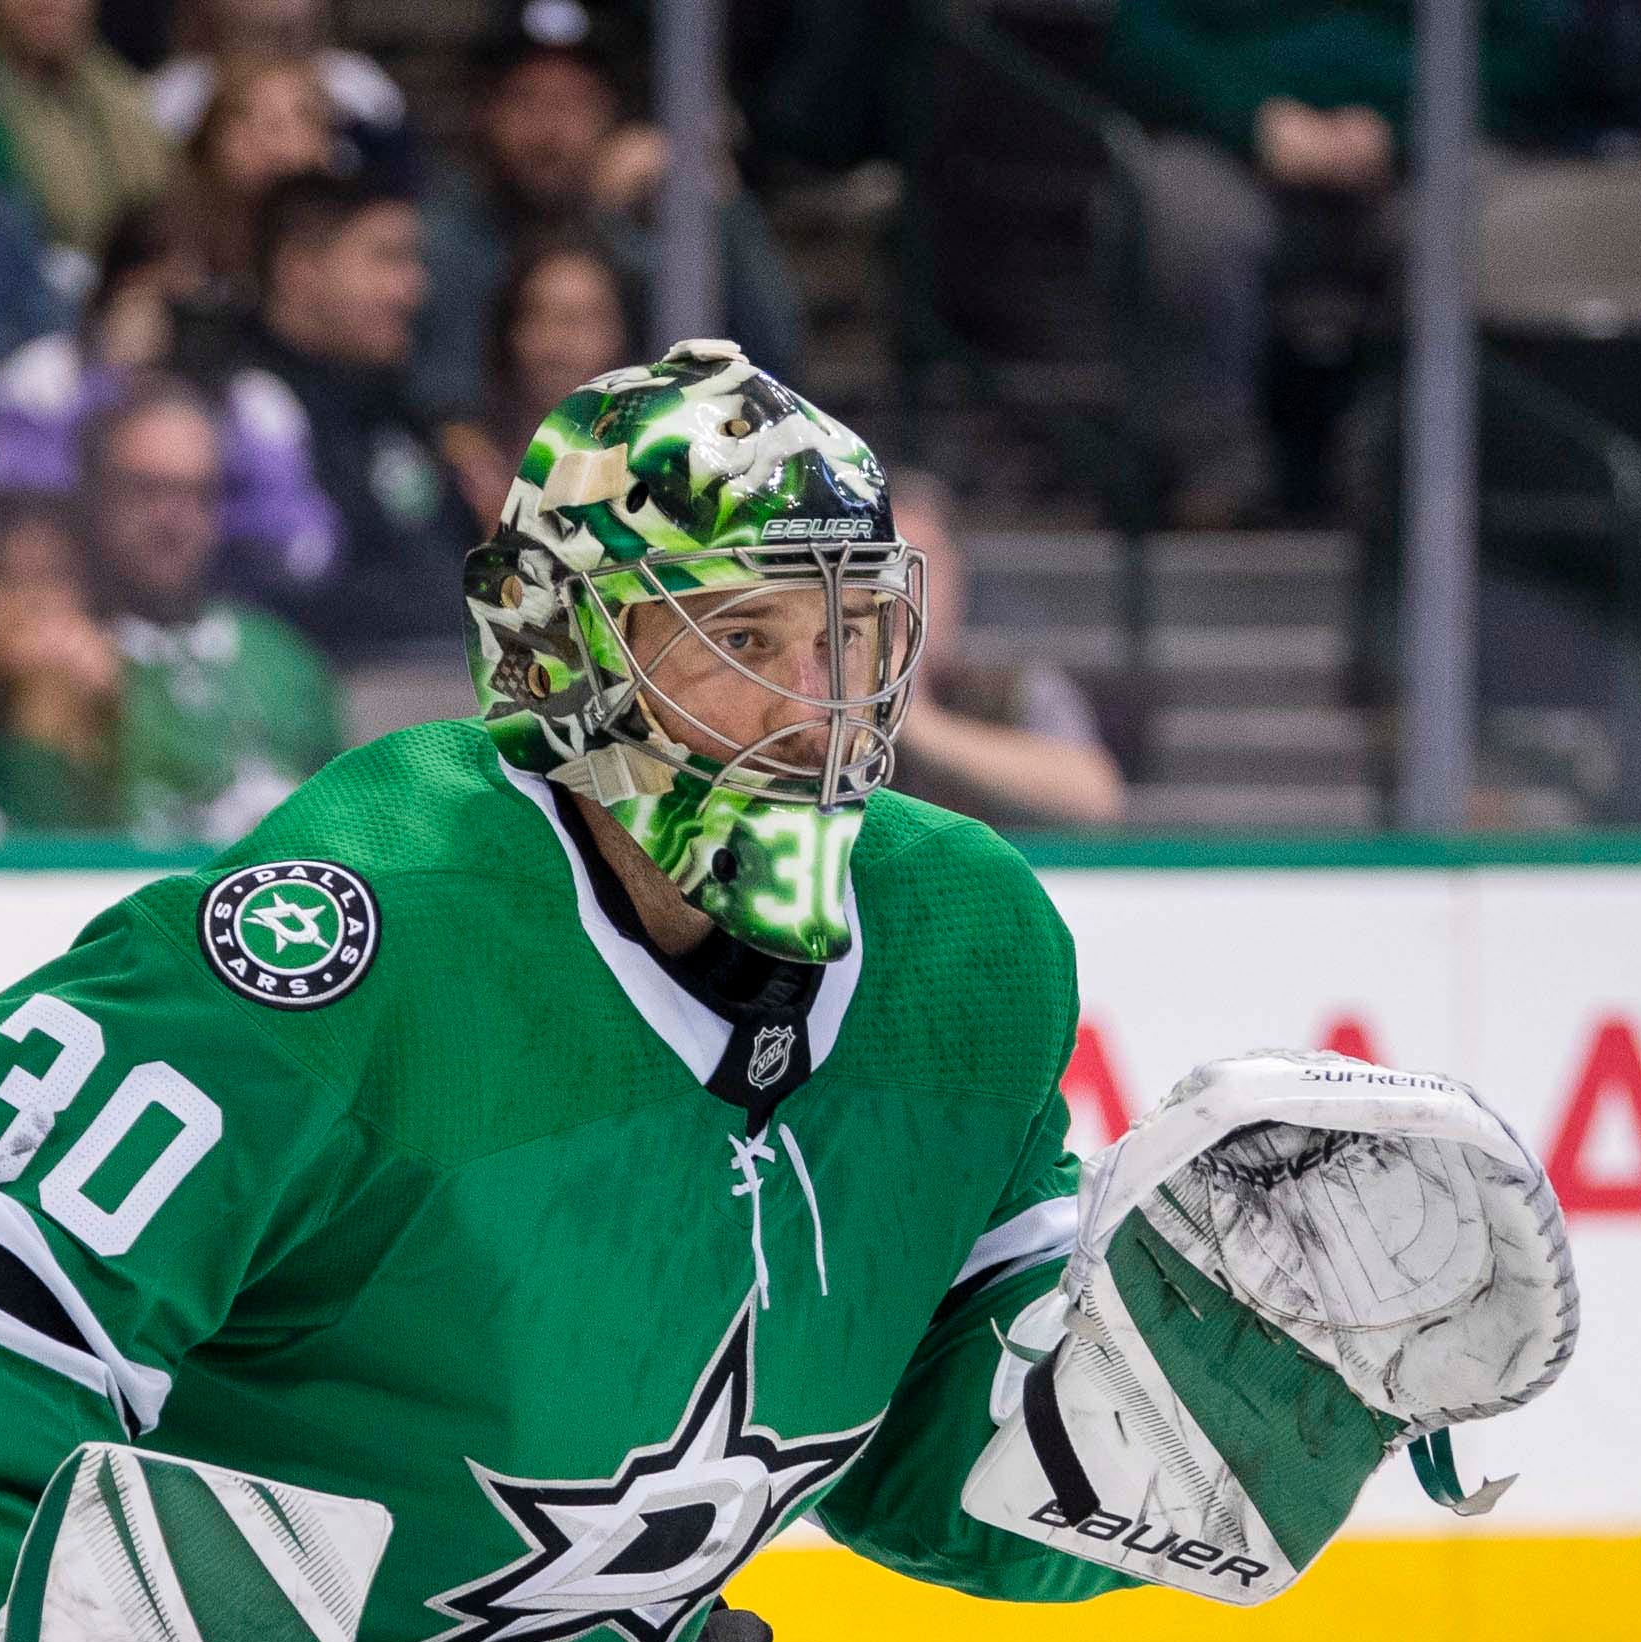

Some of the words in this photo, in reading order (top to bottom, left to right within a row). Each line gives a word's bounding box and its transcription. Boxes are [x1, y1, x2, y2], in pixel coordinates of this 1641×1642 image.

[761, 518, 874, 540] BAUER
[214, 901, 309, 996] STARS
[252, 865, 365, 965] DALLAS
[1300, 1069, 1456, 1095] SUPREME
[1027, 1498, 1270, 1588] BAUER
